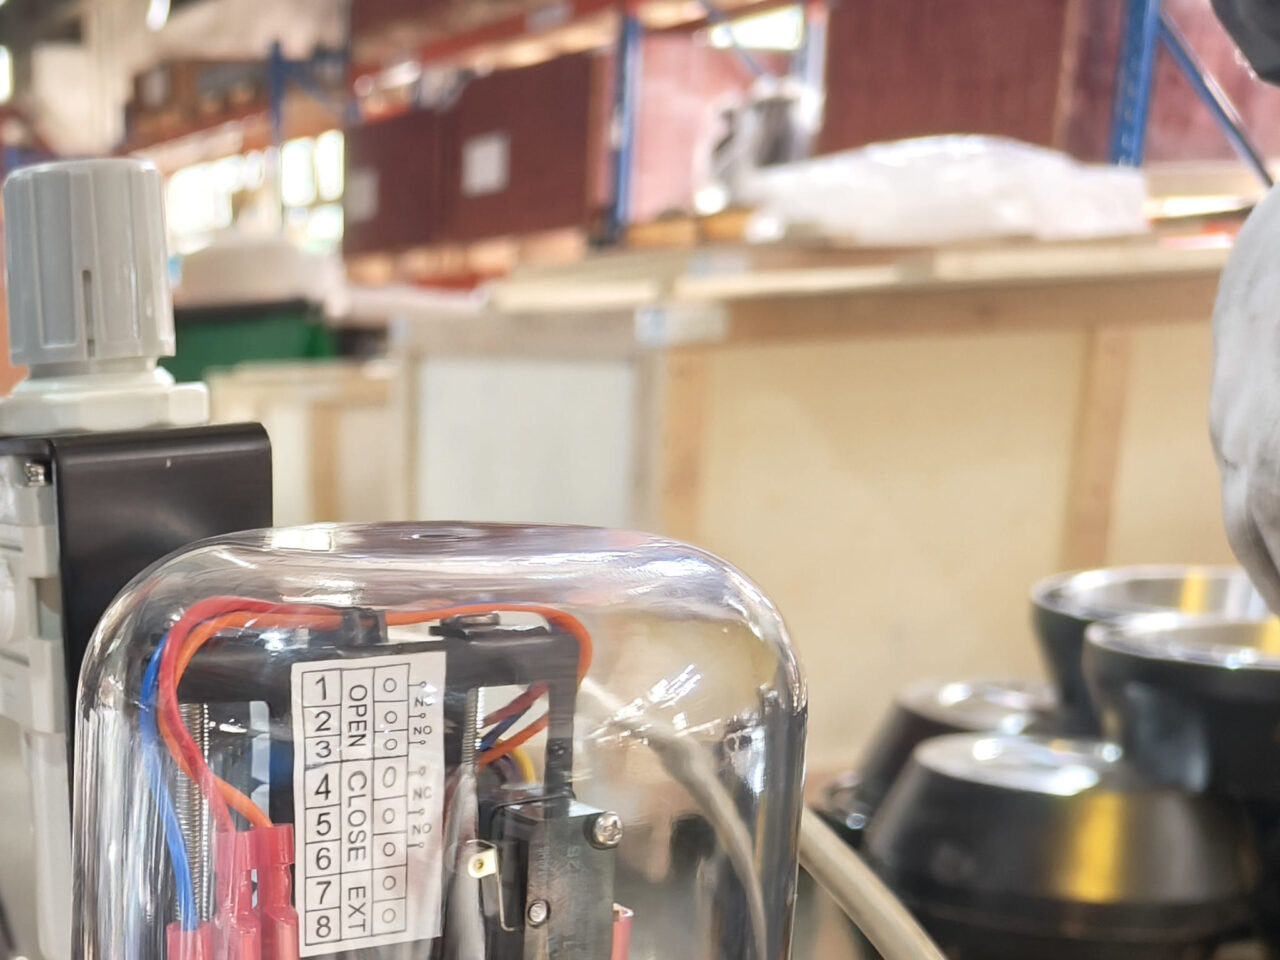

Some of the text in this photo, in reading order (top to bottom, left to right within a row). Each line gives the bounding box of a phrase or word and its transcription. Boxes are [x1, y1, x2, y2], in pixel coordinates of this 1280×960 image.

[314, 675, 327, 701] 1
[414, 694, 433, 708] N
[314, 710, 332, 732] 2
[347, 683, 368, 748] OPEN
[413, 725, 433, 736] NO
[315, 739, 332, 759] 3
[314, 772, 331, 801] 4
[412, 788, 433, 799] NC
[315, 811, 331, 836] 5
[347, 769, 367, 863] CLOSE
[412, 823, 433, 835] NO
[315, 847, 331, 871] 6
[316, 880, 332, 905] 7
[347, 886, 366, 932] EXT
[316, 914, 331, 938] 8
